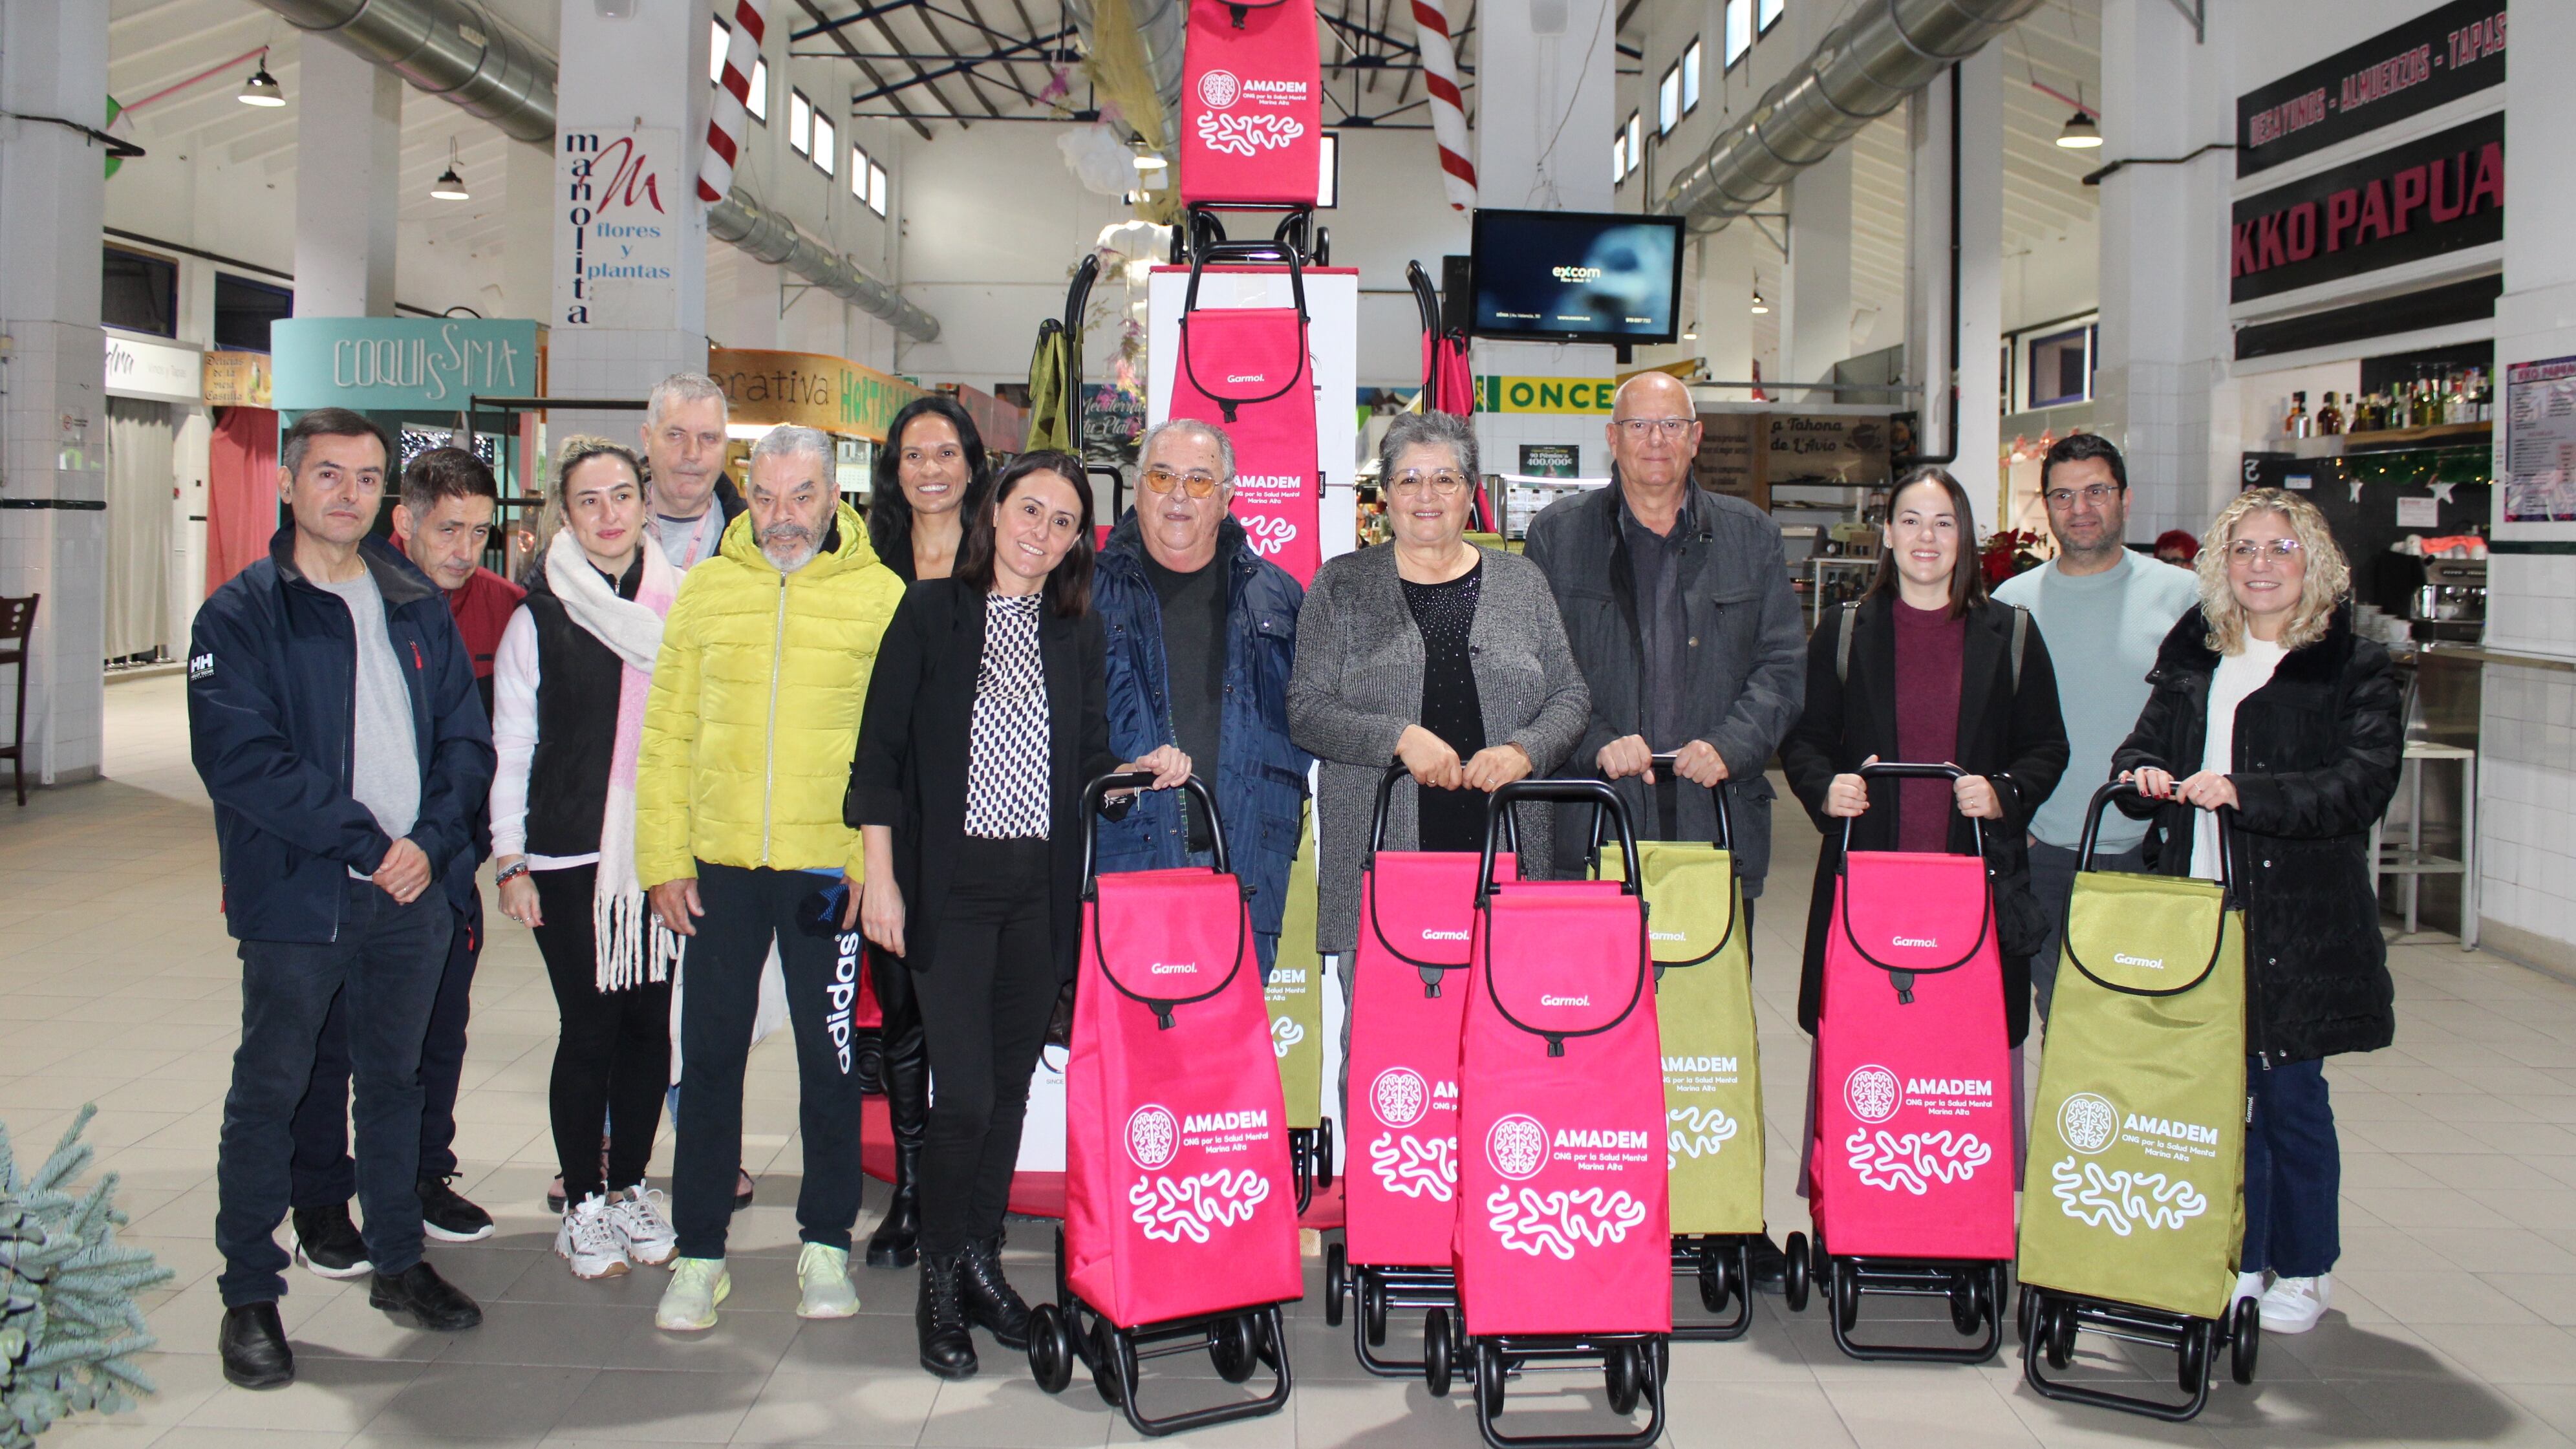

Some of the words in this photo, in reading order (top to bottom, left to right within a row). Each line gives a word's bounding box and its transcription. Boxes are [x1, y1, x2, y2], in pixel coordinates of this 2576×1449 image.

[1243, 80, 1306, 92] AMADEM
[2249, 87, 2326, 148] DESAYUNOS
[2340, 43, 2430, 113] ALMUERZOS
[2449, 11, 2507, 70] TAPAS
[2231, 200, 2317, 278] KKO
[2328, 141, 2504, 253] PAPUA
[566, 134, 598, 323] manolita
[597, 222, 661, 237] flores
[621, 244, 633, 259] y
[587, 263, 671, 279] plantas
[1552, 266, 1601, 278] excom
[205, 356, 244, 366] Delicias
[334, 323, 518, 400] COQUISSIMA
[213, 368, 222, 377] de
[226, 368, 235, 377] la
[1227, 374, 1265, 383] Garmol.
[205, 391, 243, 402] Castilla
[1510, 382, 1615, 409] ONCE
[1787, 418, 1842, 431] Tahona
[1770, 438, 1788, 451] de
[191, 653, 213, 673] HH
[1422, 929, 1469, 940] Garmol.
[1649, 931, 1686, 941] armol.
[1893, 936, 1937, 947] Garmol.
[1152, 962, 1197, 974] Garmol.
[2114, 953, 2164, 969] Garmol.
[1269, 969, 1305, 983] DEM
[827, 932, 859, 1075] adidas
[1541, 994, 1590, 1006] Garmol.
[1905, 1078, 1991, 1095] AMADEM
[1183, 1110, 1267, 1133] AMADEM
[2123, 1113, 2218, 1145] AMADEM
[1224, 1134, 1243, 1143] Salud
[1245, 1132, 1268, 1141] Mental
[1554, 1130, 1648, 1148] AMADEM
[2121, 1134, 2140, 1143] ONG
[2167, 1142, 2187, 1152] Salud
[2190, 1146, 2216, 1157] Mental
[1574, 1154, 1587, 1162] por
[2145, 1147, 2171, 1158] Marina
[2173, 1153, 2189, 1161] Alta
